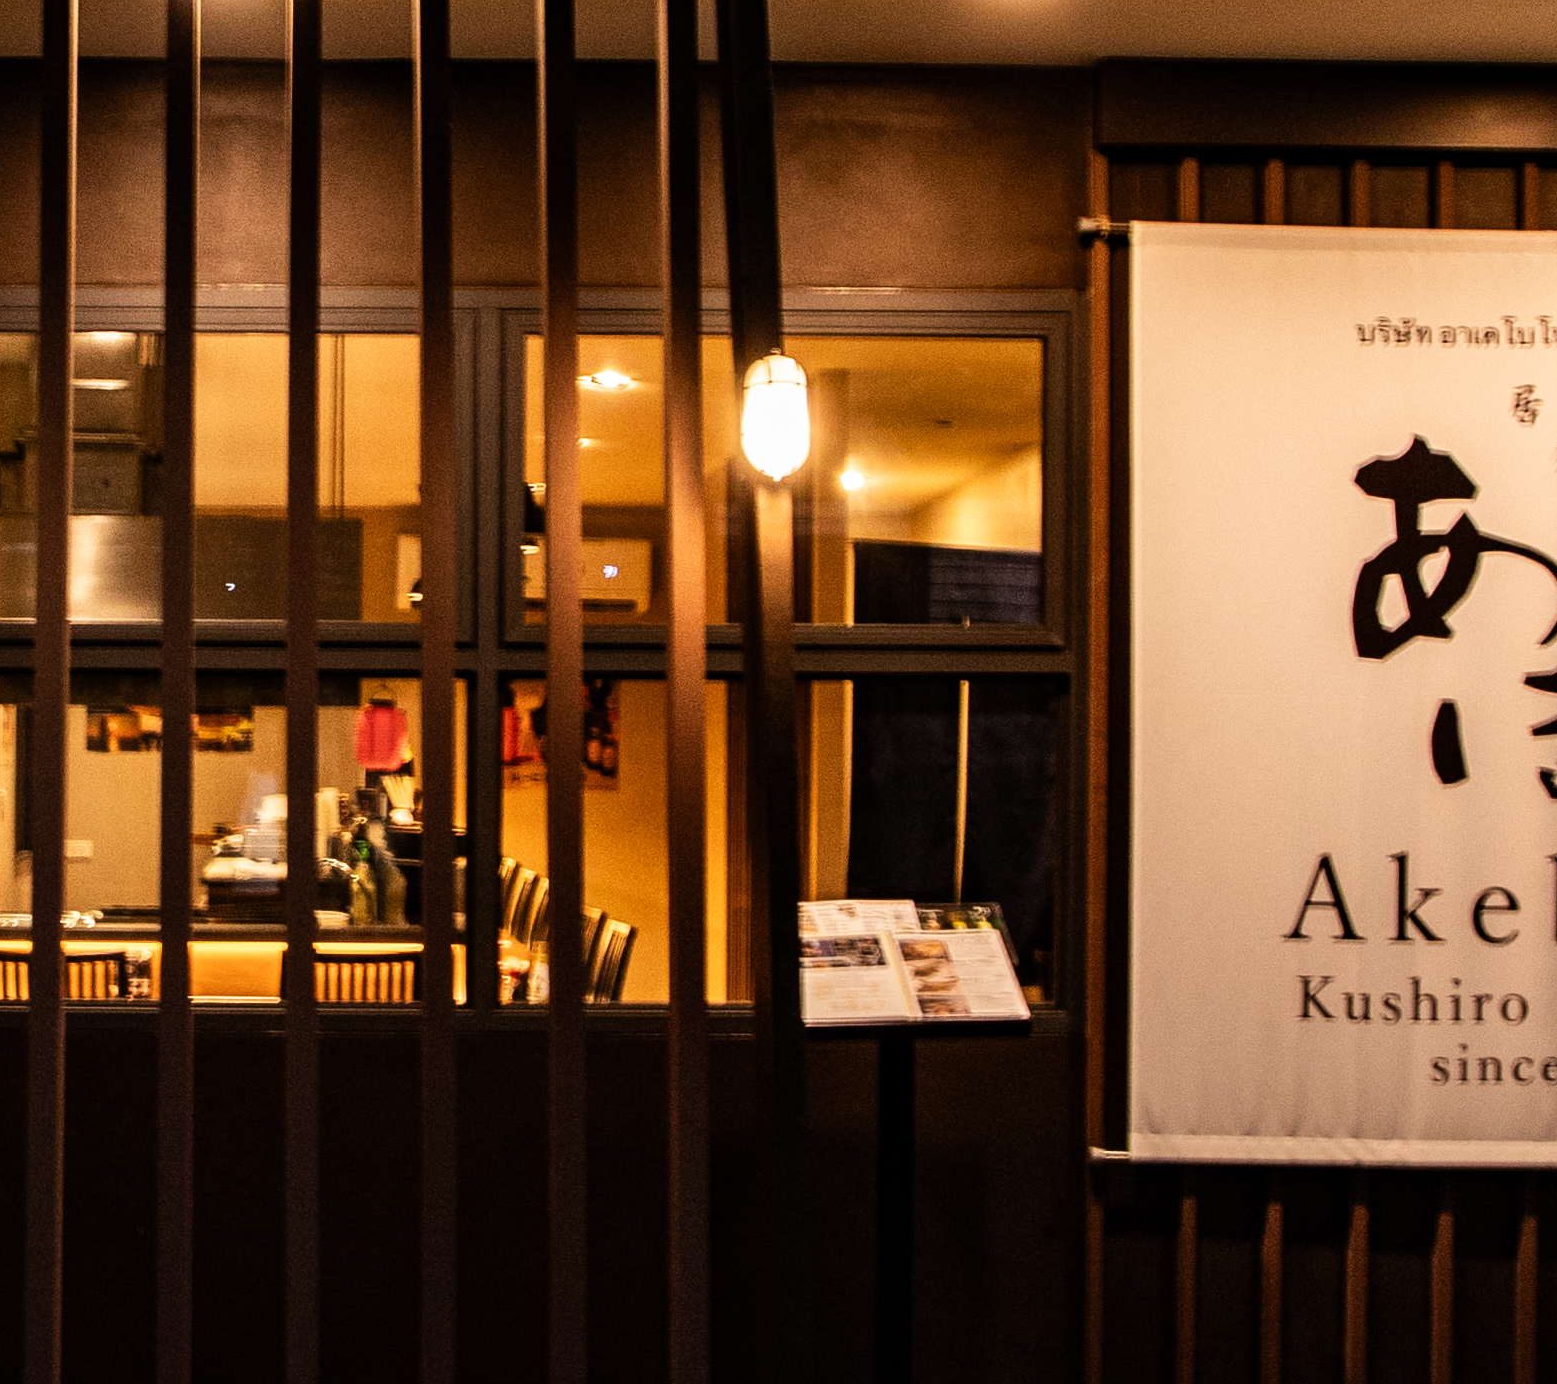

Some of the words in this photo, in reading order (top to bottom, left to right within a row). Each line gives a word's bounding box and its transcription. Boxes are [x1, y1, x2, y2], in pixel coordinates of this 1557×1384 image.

[1356, 315, 1433, 347] บริษัท
[1295, 975, 1530, 1026] Kushiro
